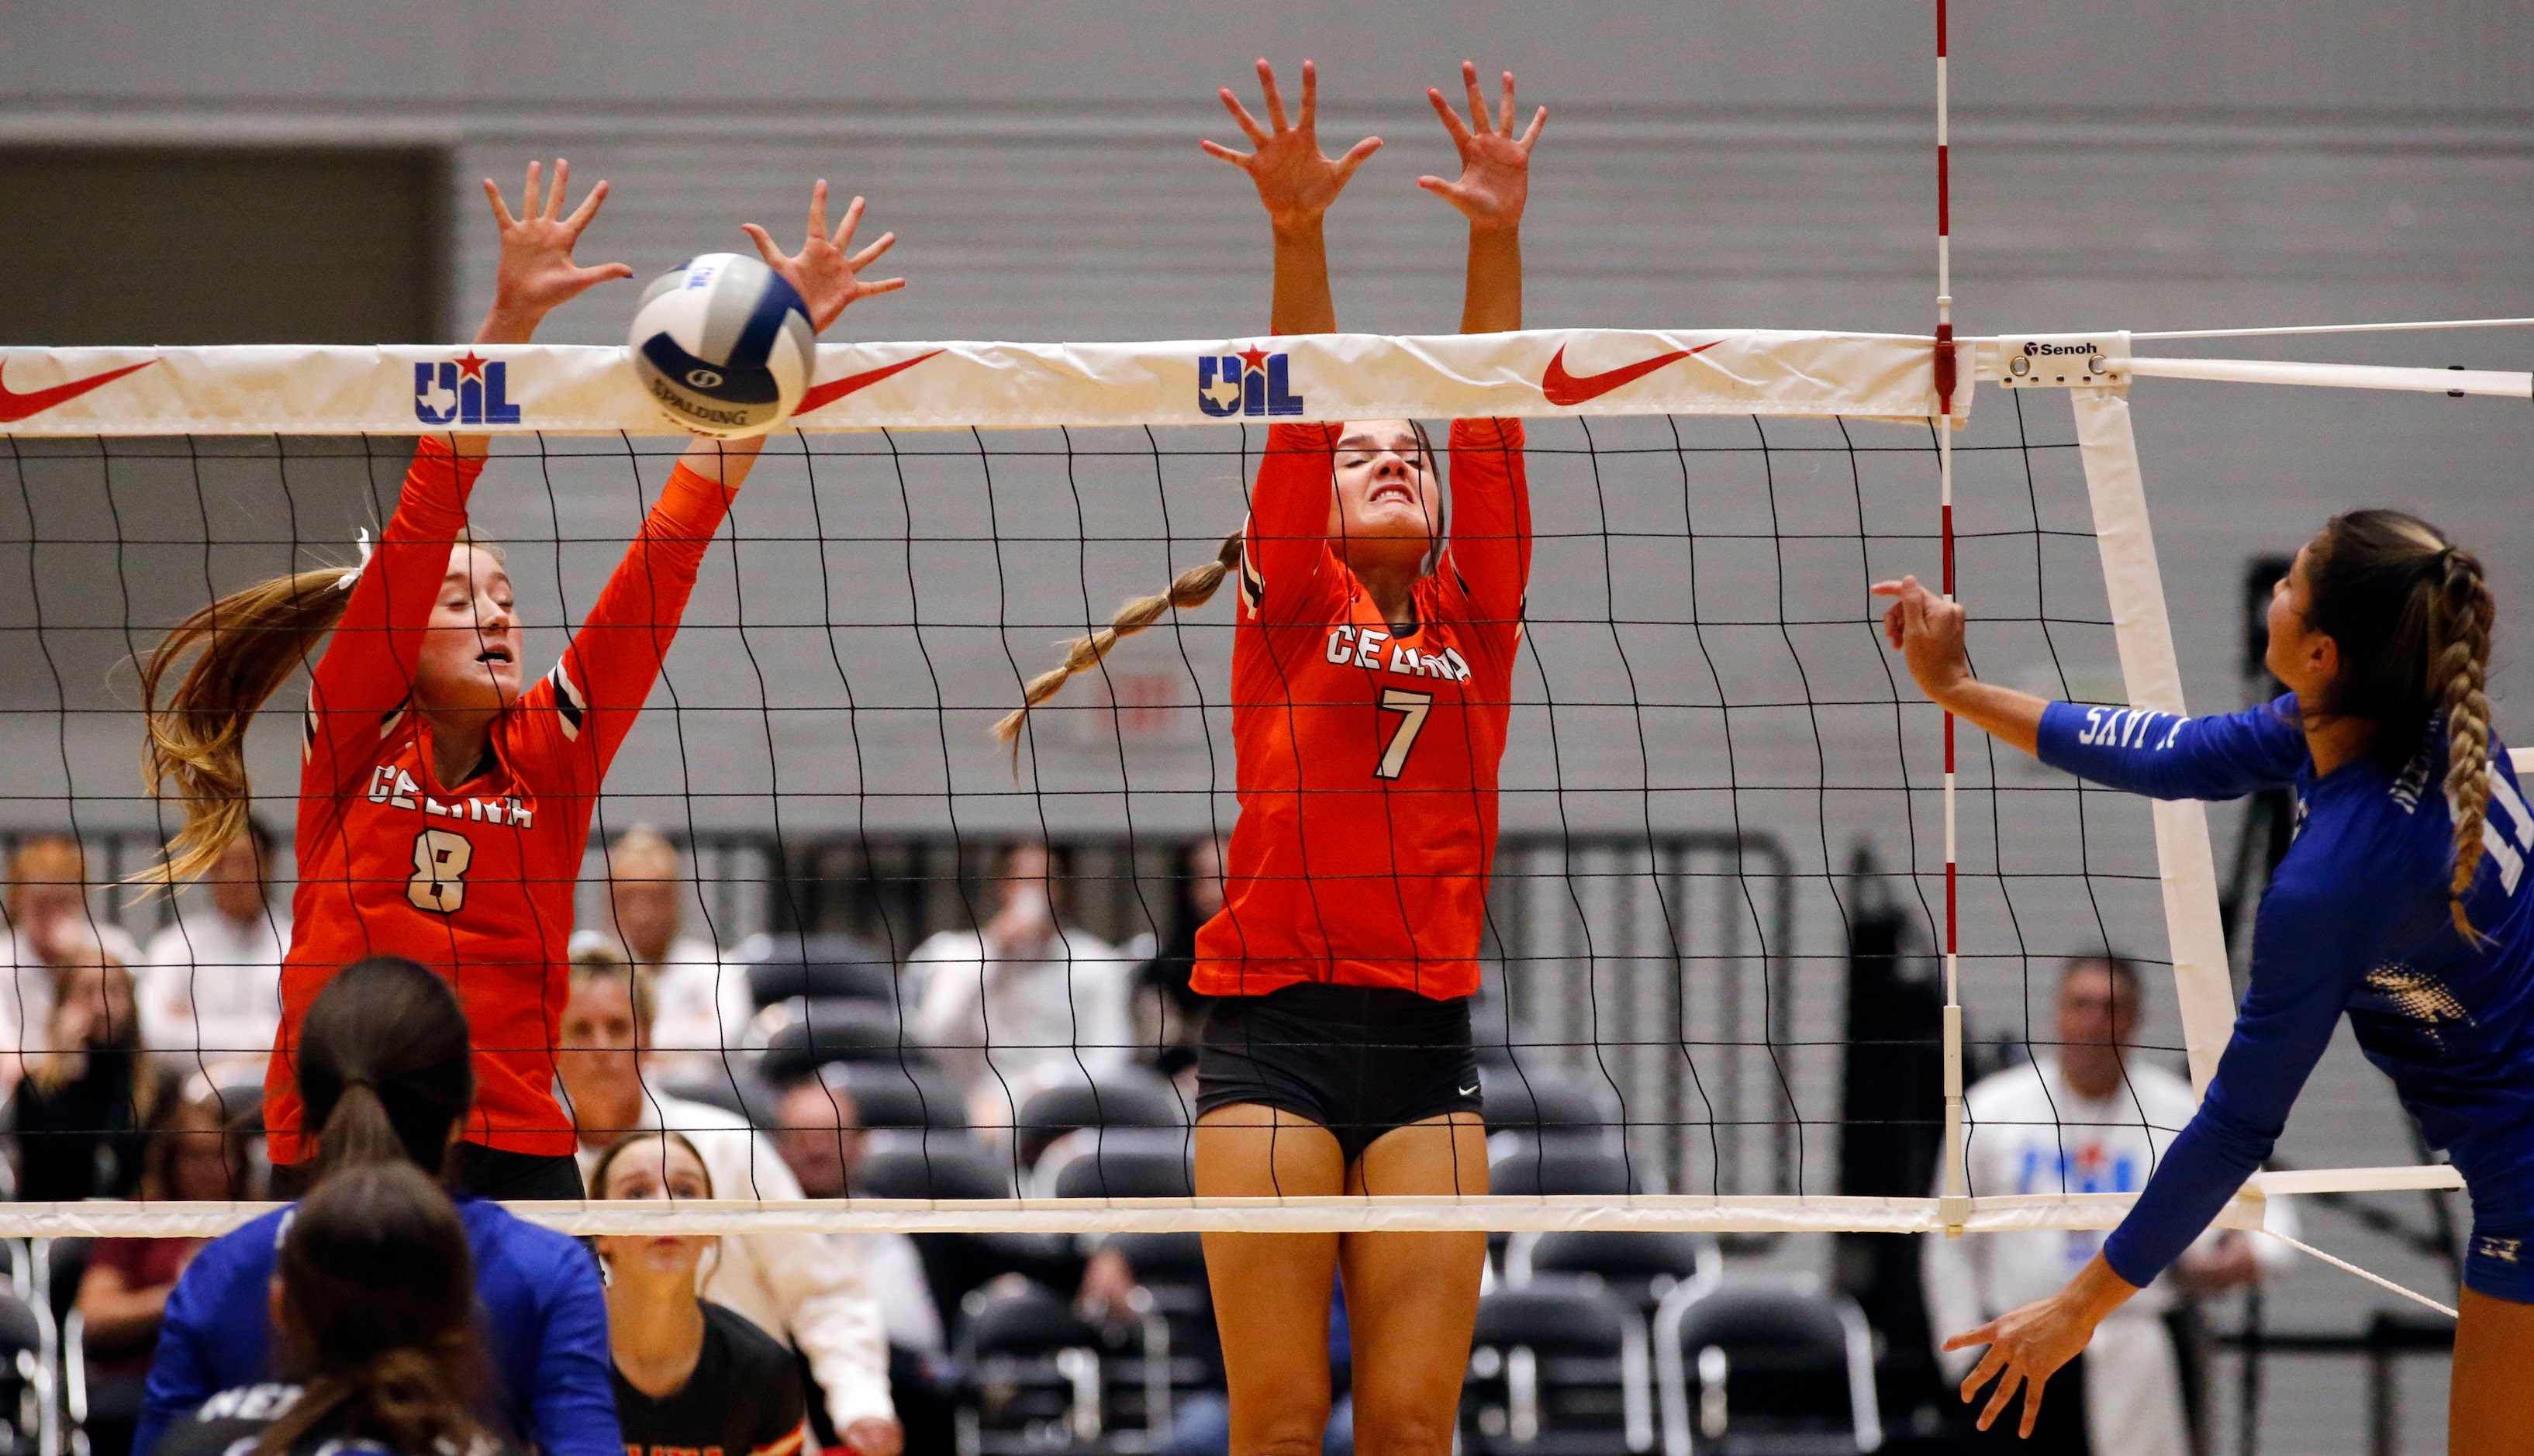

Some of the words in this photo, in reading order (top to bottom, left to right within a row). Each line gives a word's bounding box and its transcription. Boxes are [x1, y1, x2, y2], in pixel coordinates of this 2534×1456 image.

[2041, 343, 2097, 355] Senoh
[654, 378, 747, 426] SPALDING
[1372, 686, 1434, 781] 7
[405, 826, 475, 916] 8
